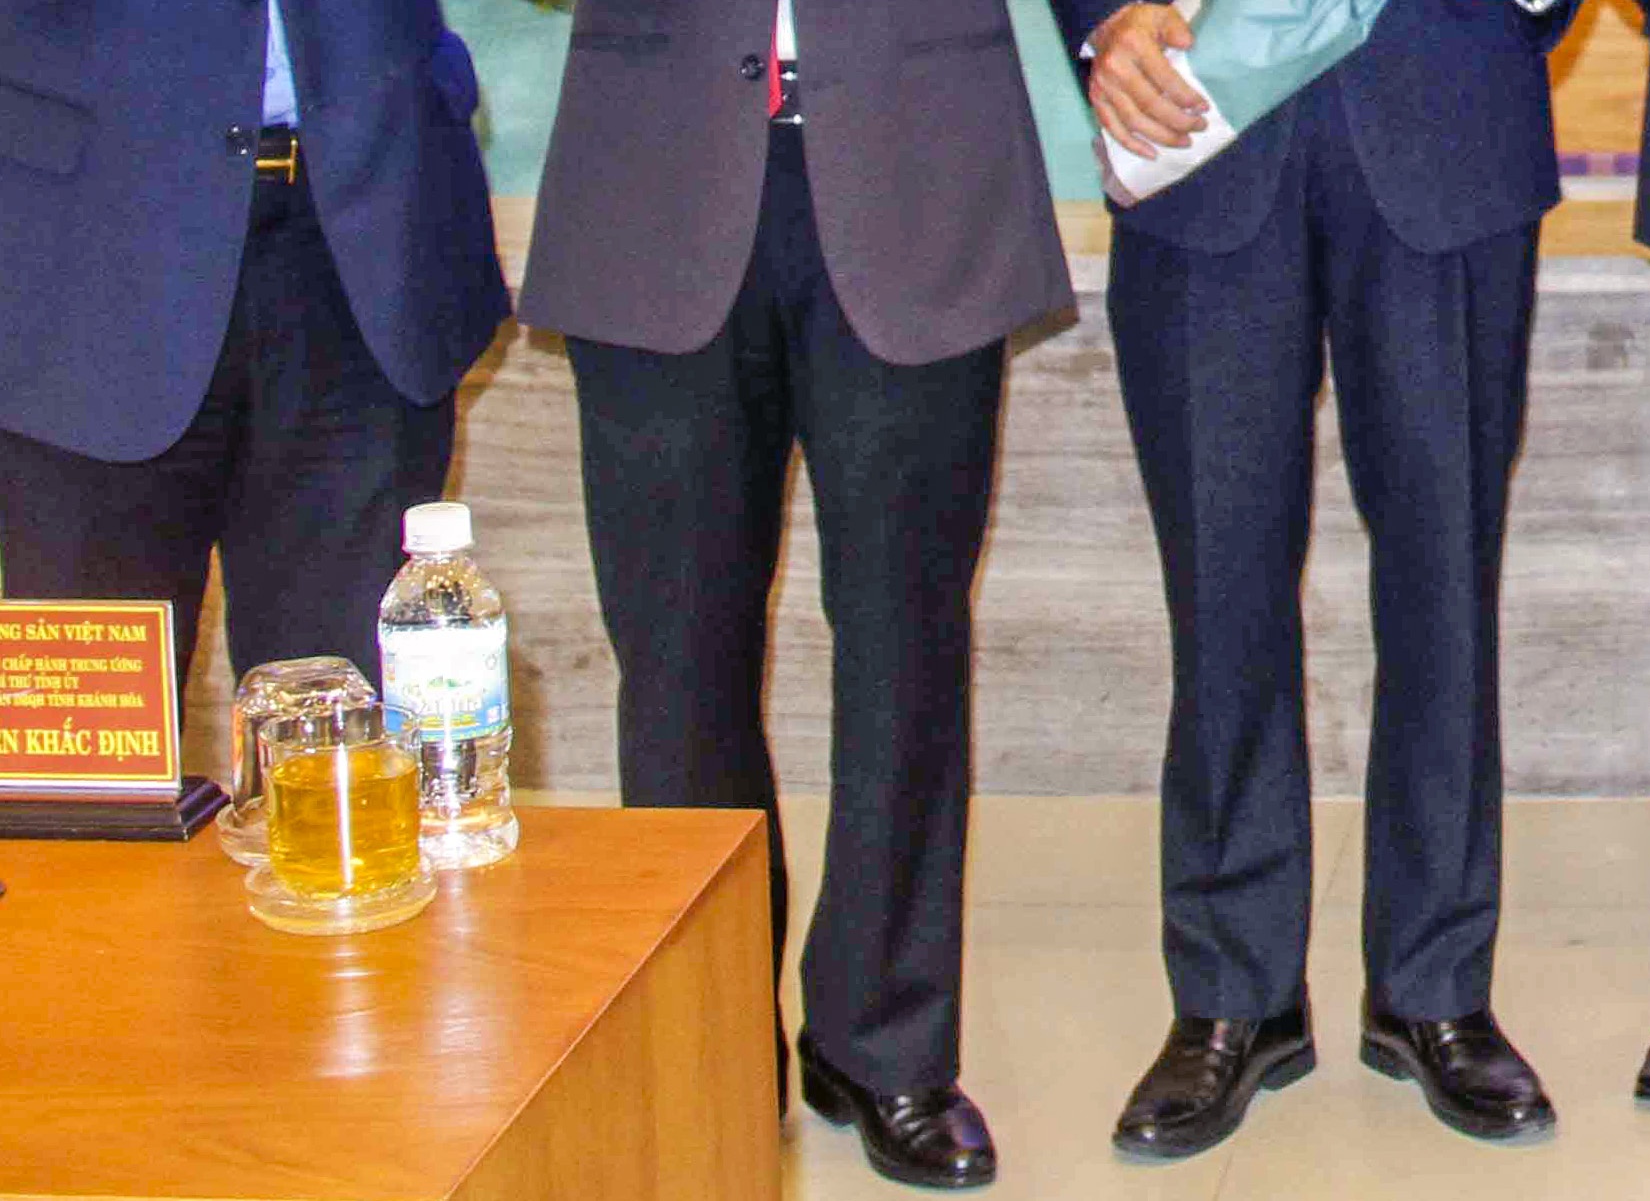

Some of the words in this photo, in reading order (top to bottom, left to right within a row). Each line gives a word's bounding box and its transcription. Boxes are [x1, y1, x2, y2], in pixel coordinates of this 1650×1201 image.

[25, 617, 60, 641] SẢN
[63, 620, 105, 645] VIỆT
[107, 624, 147, 642] NAM
[24, 716, 92, 756] KHẮC
[97, 729, 161, 762] ĐỊNH
